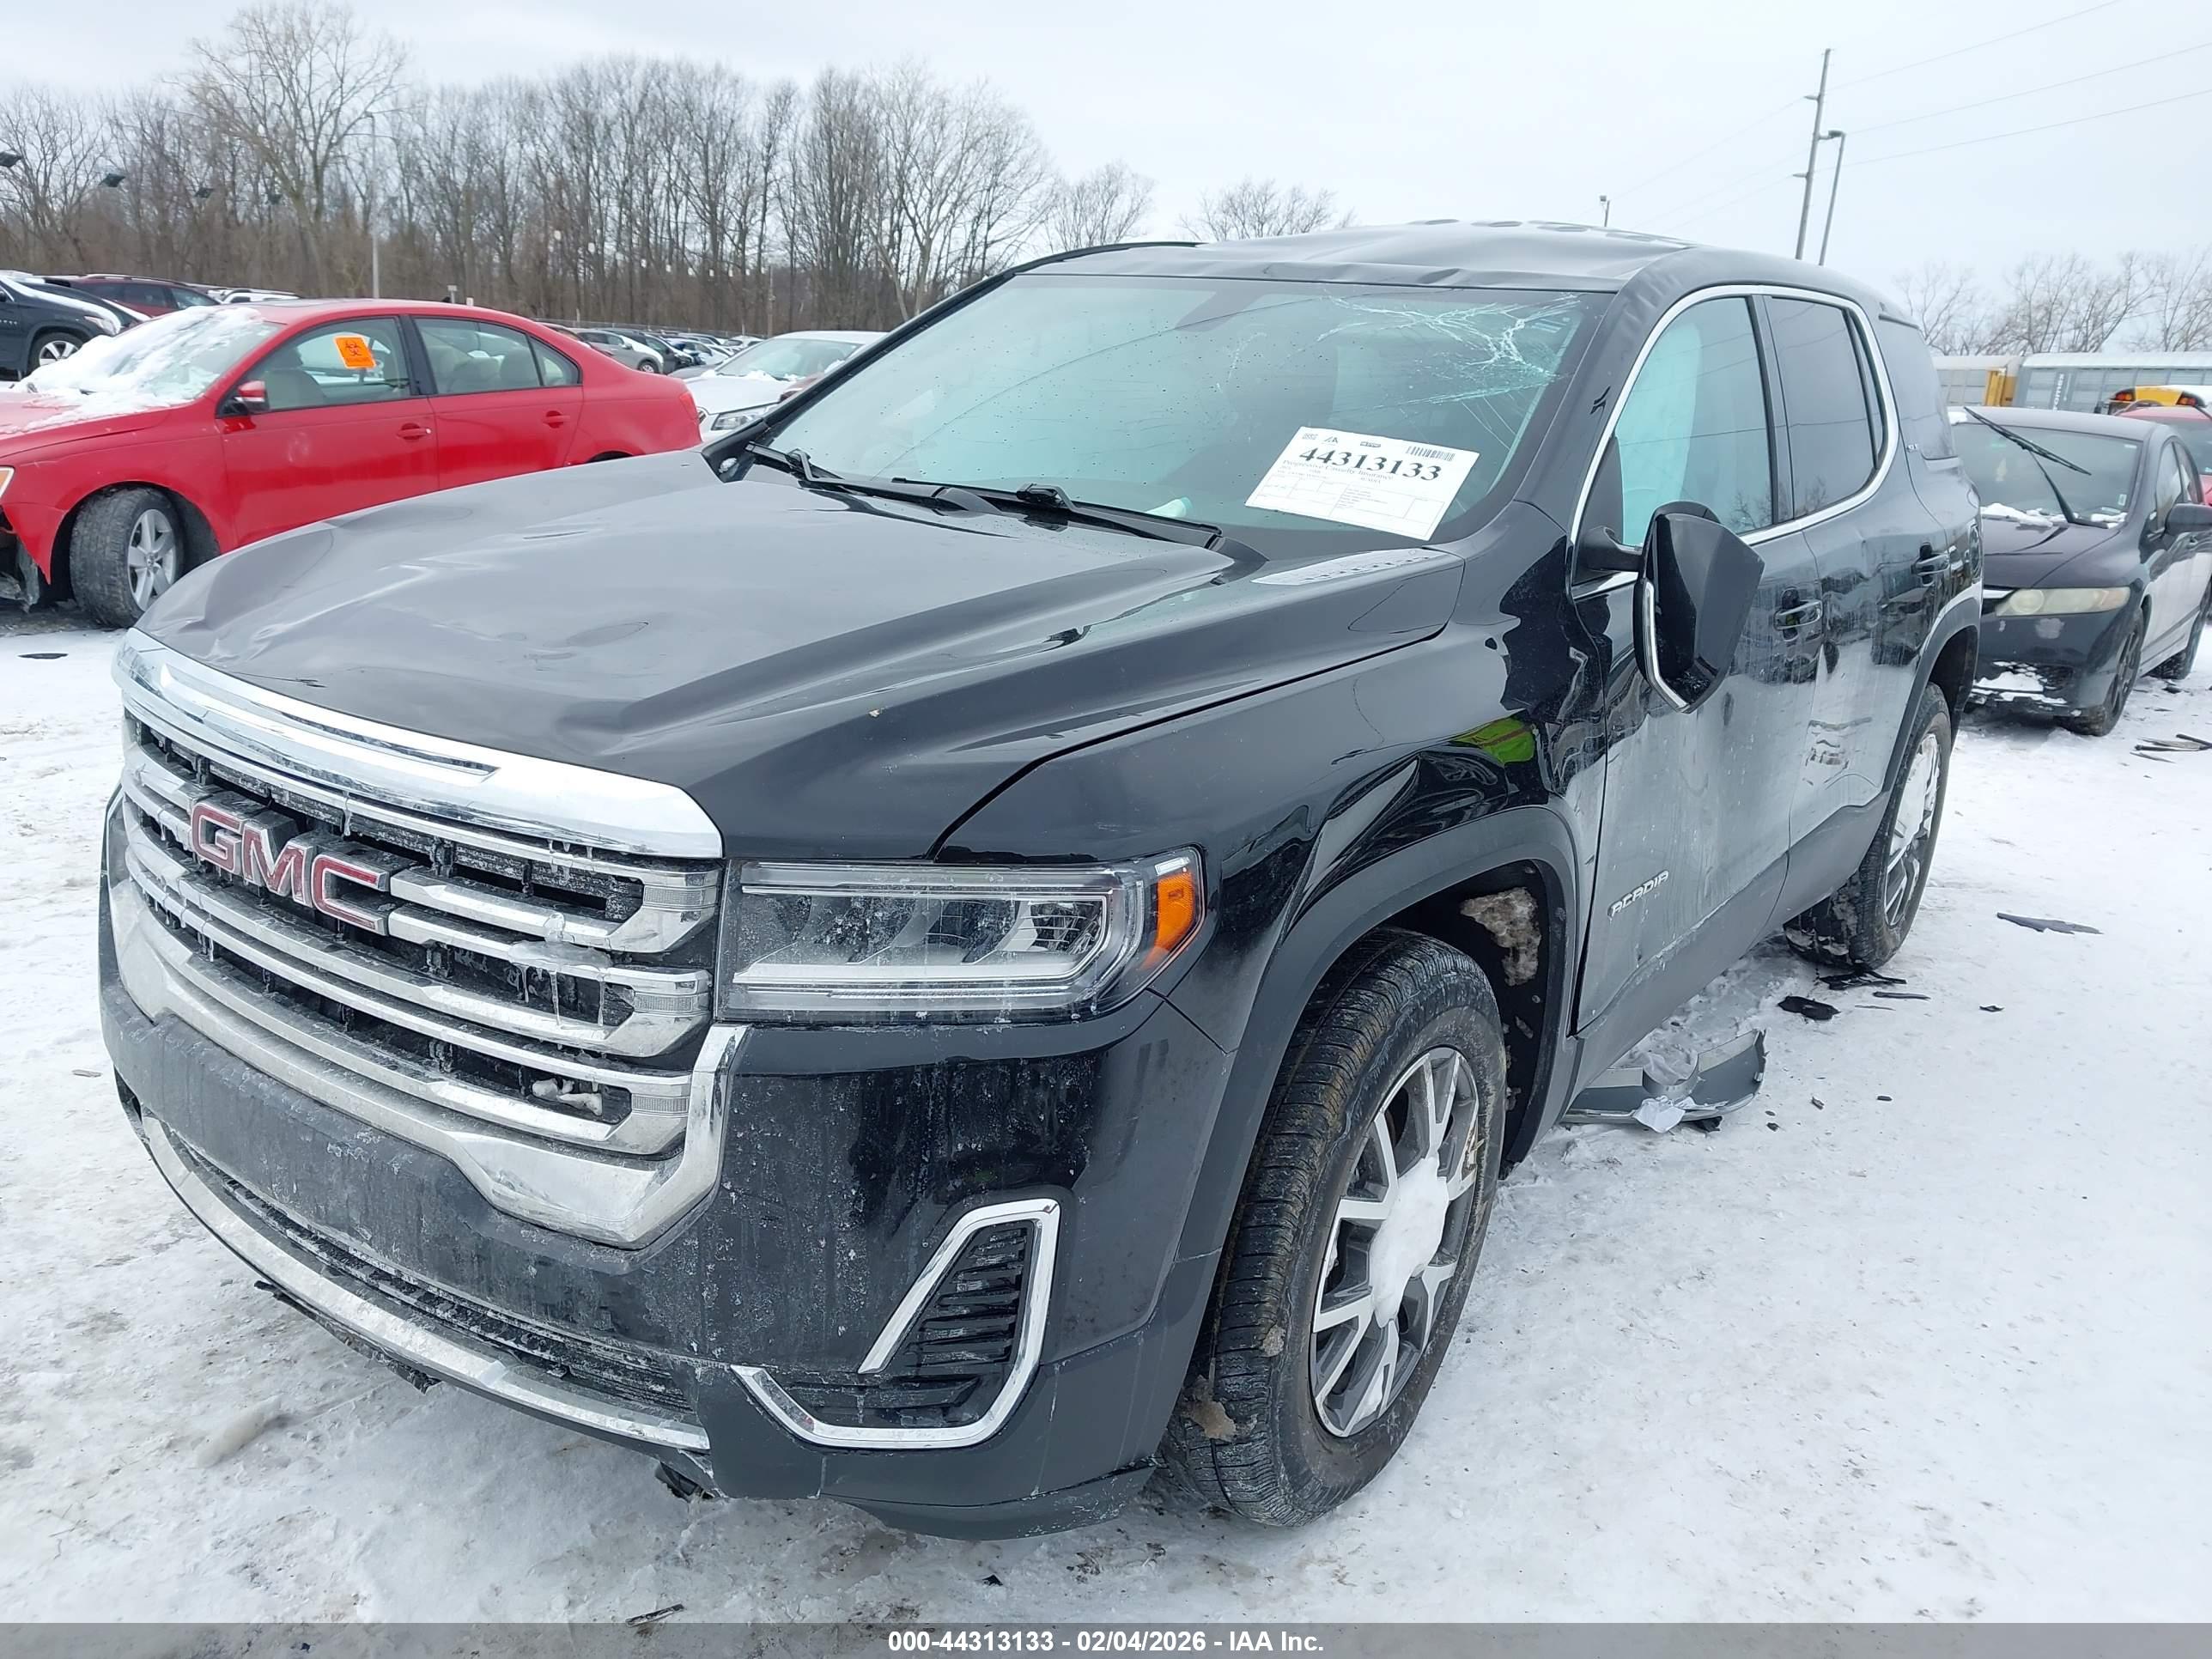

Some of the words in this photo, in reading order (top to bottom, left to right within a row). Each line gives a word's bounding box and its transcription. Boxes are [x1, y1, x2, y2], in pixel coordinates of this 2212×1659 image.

[1299, 447, 1442, 481] 44313133
[191, 802, 389, 936] GMC
[1608, 869, 1668, 917] ACADIA
